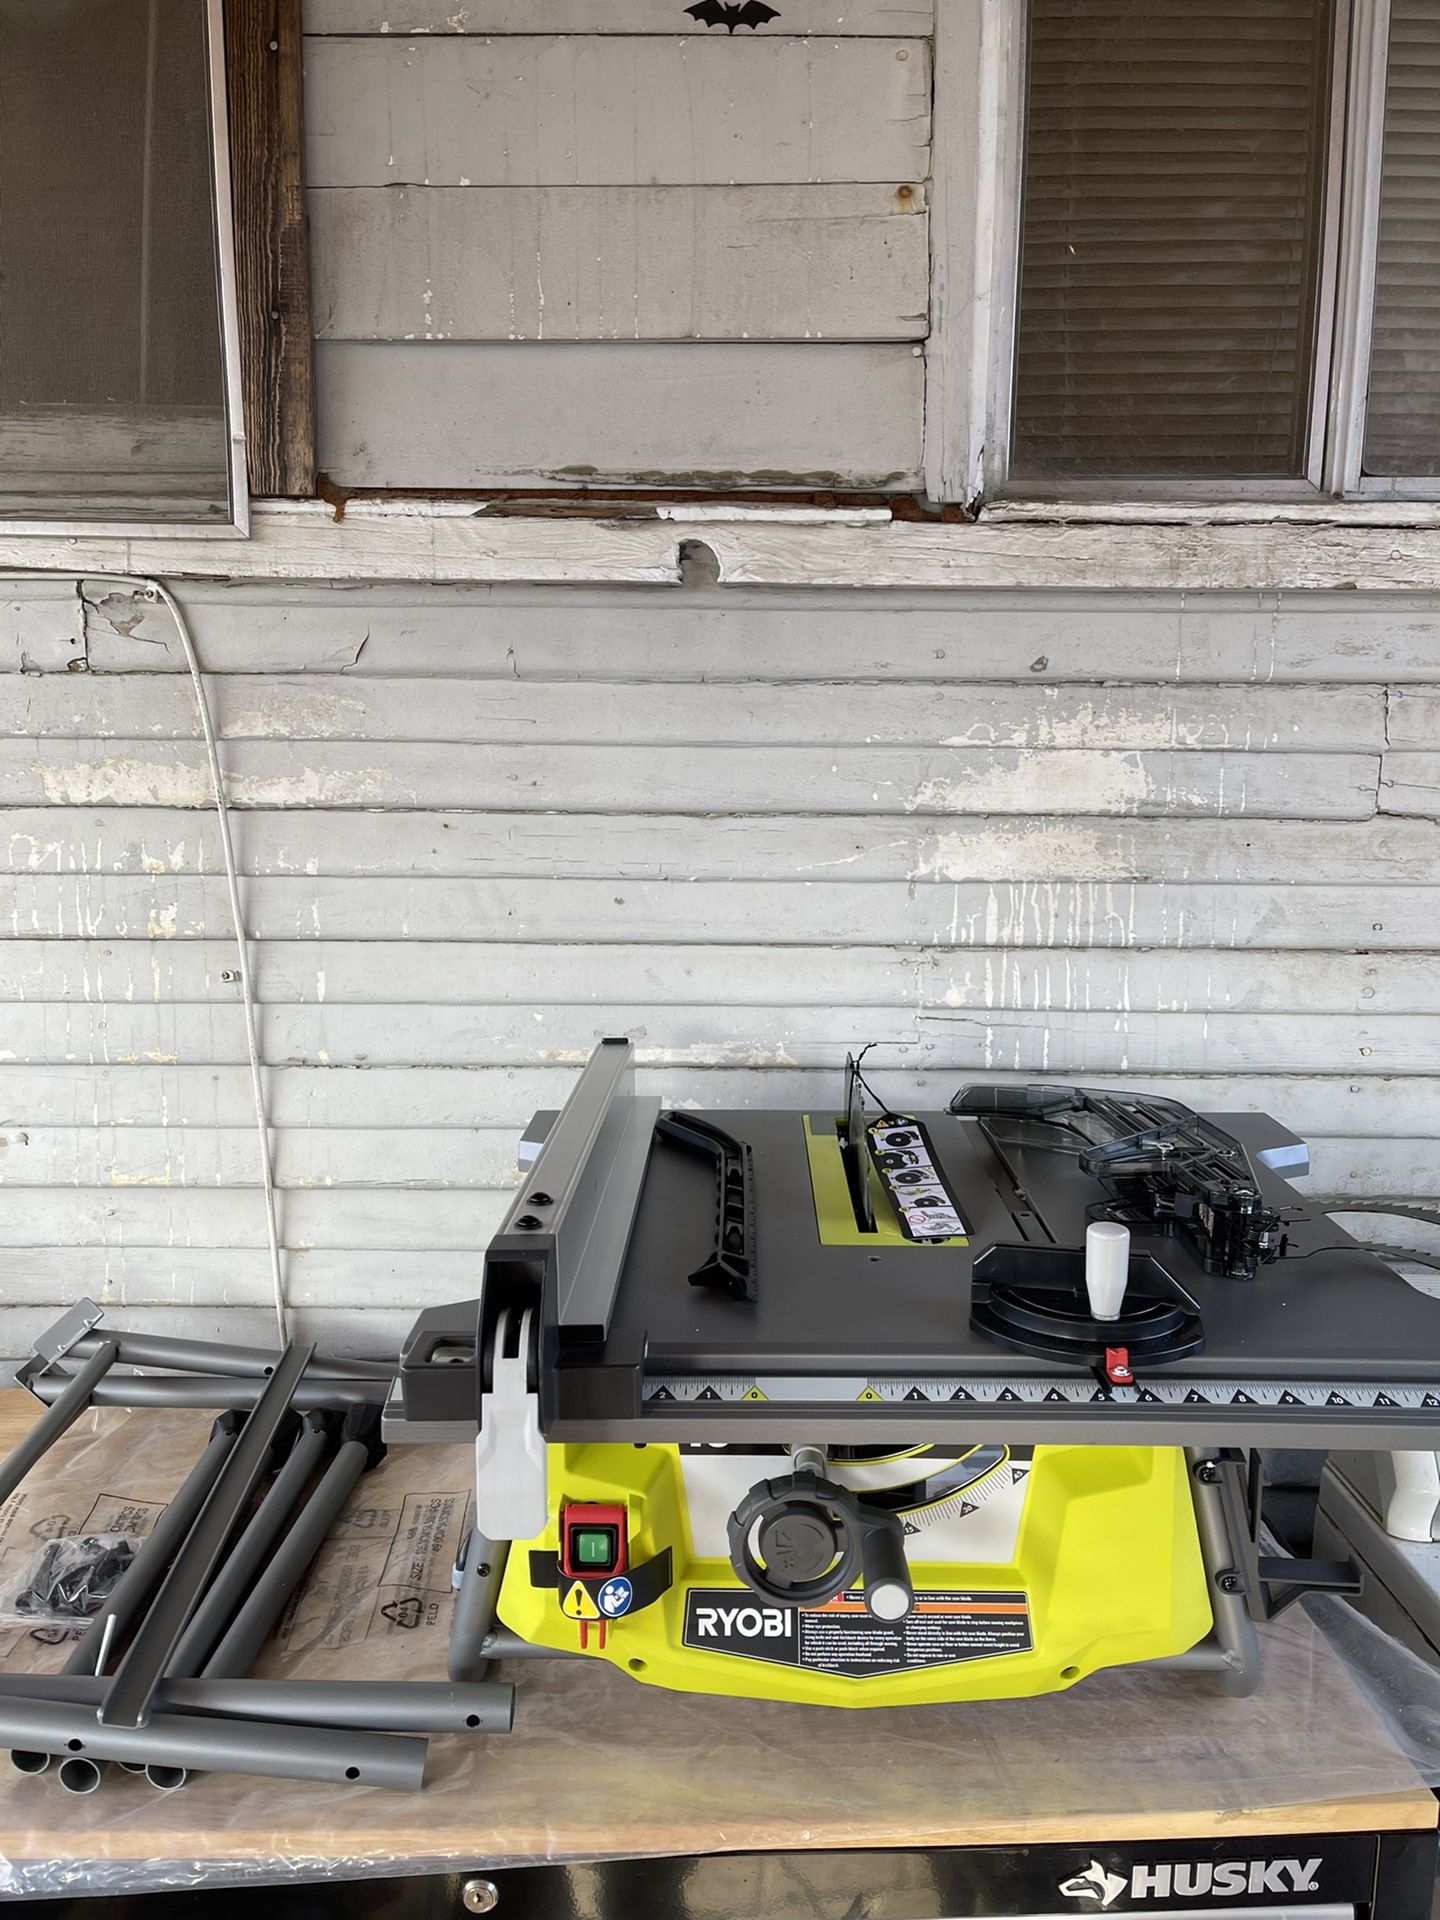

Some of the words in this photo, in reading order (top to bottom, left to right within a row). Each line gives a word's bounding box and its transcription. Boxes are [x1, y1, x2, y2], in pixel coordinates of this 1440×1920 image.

[659, 1391, 666, 1399] 2
[751, 1391, 758, 1399] 0
[866, 1392, 873, 1400] 0
[912, 1392, 918, 1400] 1
[958, 1392, 966, 1400] 2
[1005, 1393, 1012, 1401] 3
[1051, 1393, 1058, 1401] 4
[1098, 1393, 1105, 1401] 5
[1238, 1395, 1246, 1403] 8
[1332, 1397, 1343, 1405] 10
[1427, 1398, 1440, 1406] 12
[1013, 1470, 1023, 1480] 45
[963, 1505, 973, 1513] 30
[905, 1526, 914, 1534] 15
[425, 1603, 440, 1626] PELD
[696, 1607, 792, 1637] RYOBI
[1131, 1858, 1323, 1898] HUSKY
